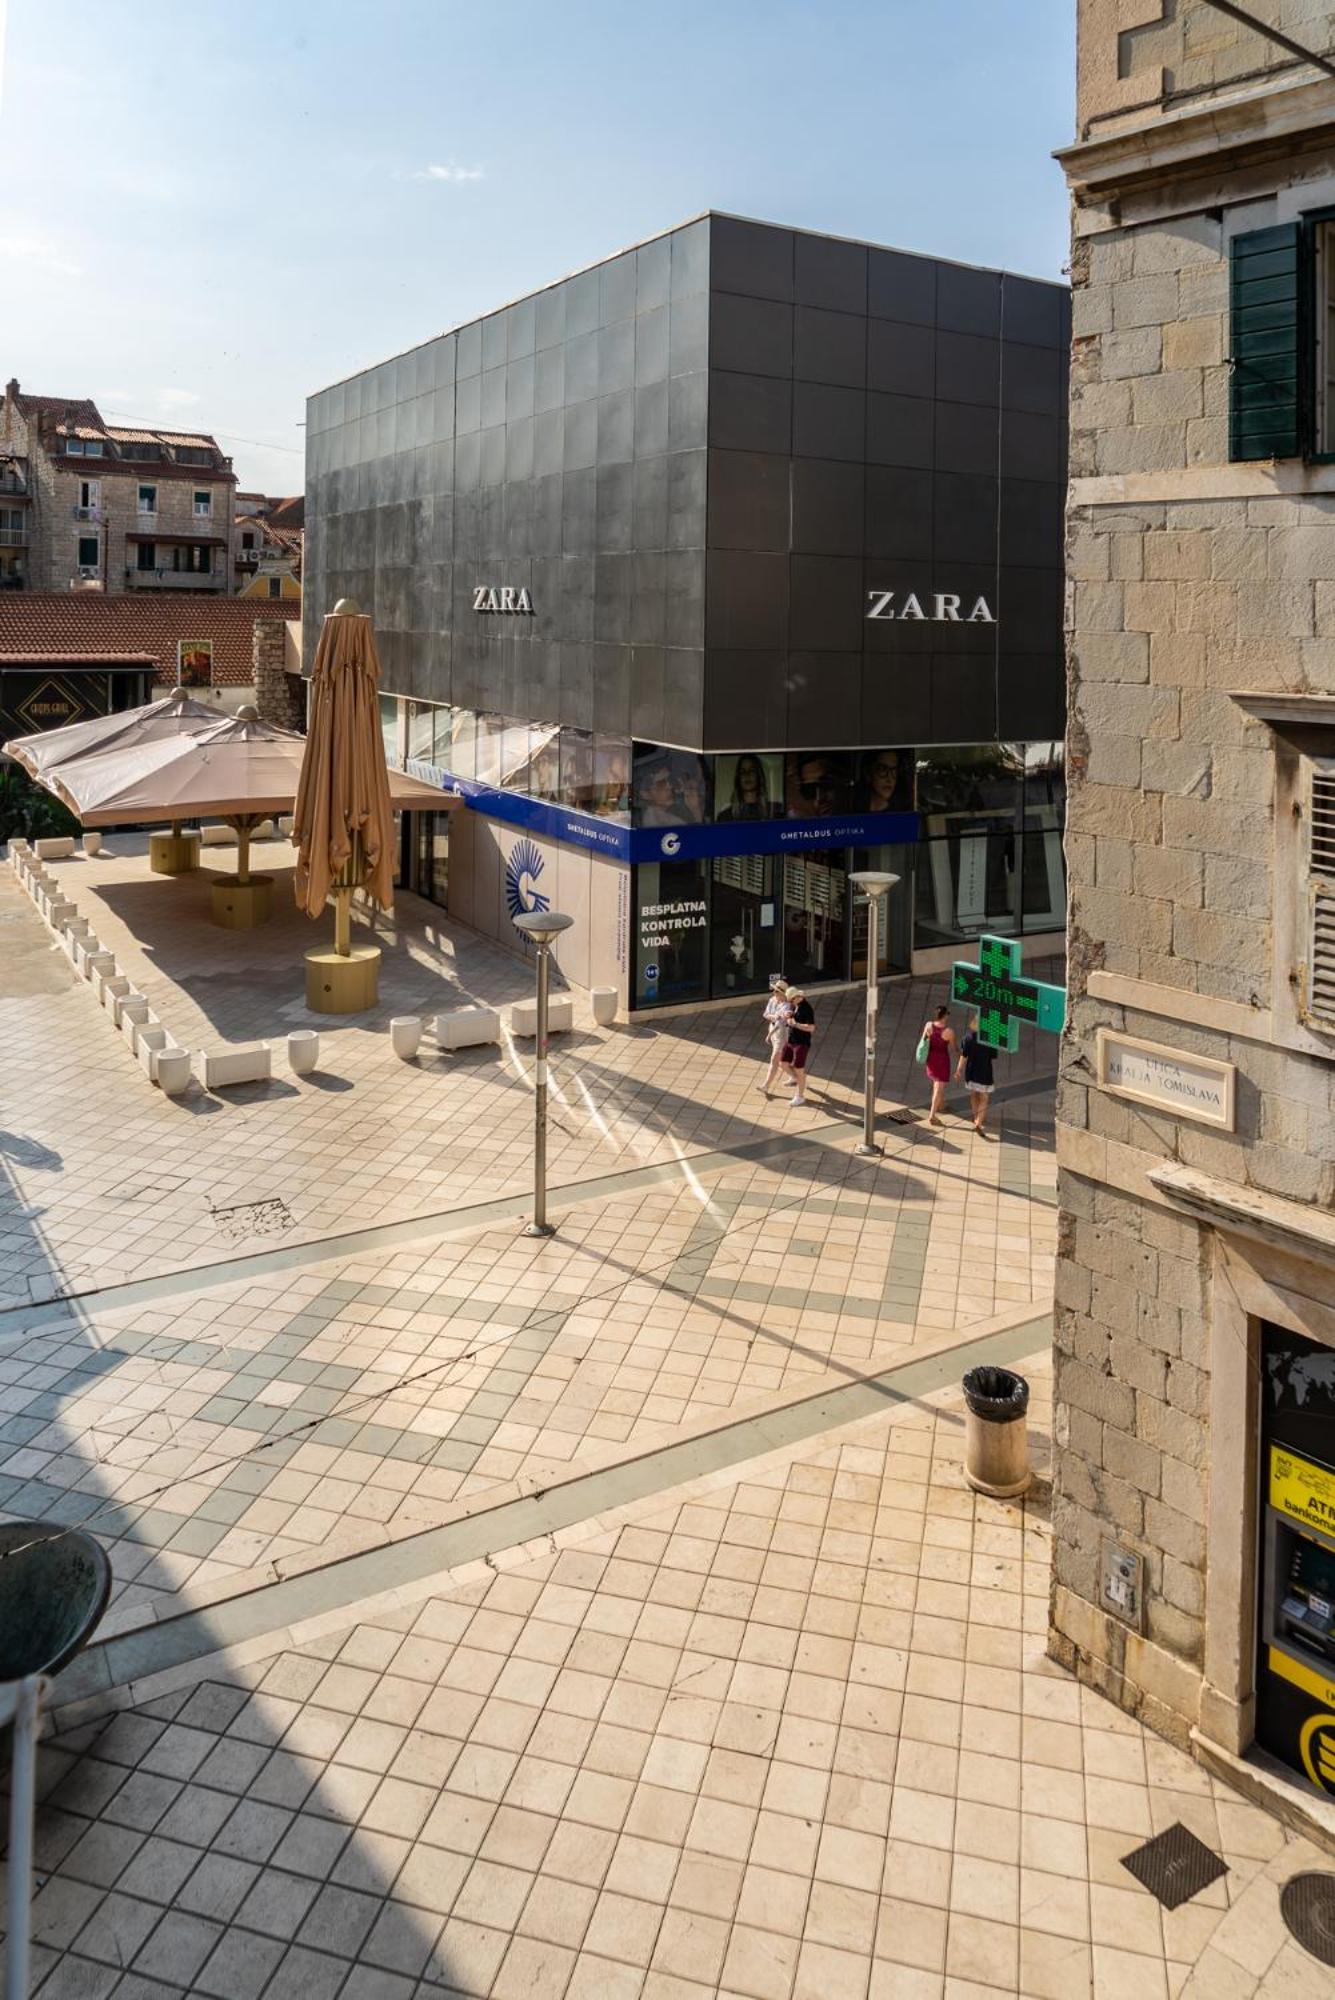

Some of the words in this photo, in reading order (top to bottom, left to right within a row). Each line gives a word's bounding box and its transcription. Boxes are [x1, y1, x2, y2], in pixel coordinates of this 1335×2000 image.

[473, 586, 532, 611] ZARA
[865, 591, 998, 622] ZARA
[780, 829, 832, 841] GHETALDUS
[641, 901, 706, 917] BESPLATNA
[641, 916, 707, 932] KONTROLA
[642, 935, 670, 948] VIDA
[1146, 1057, 1180, 1077] ULICA
[1157, 1075, 1220, 1105] TOMISLAVA
